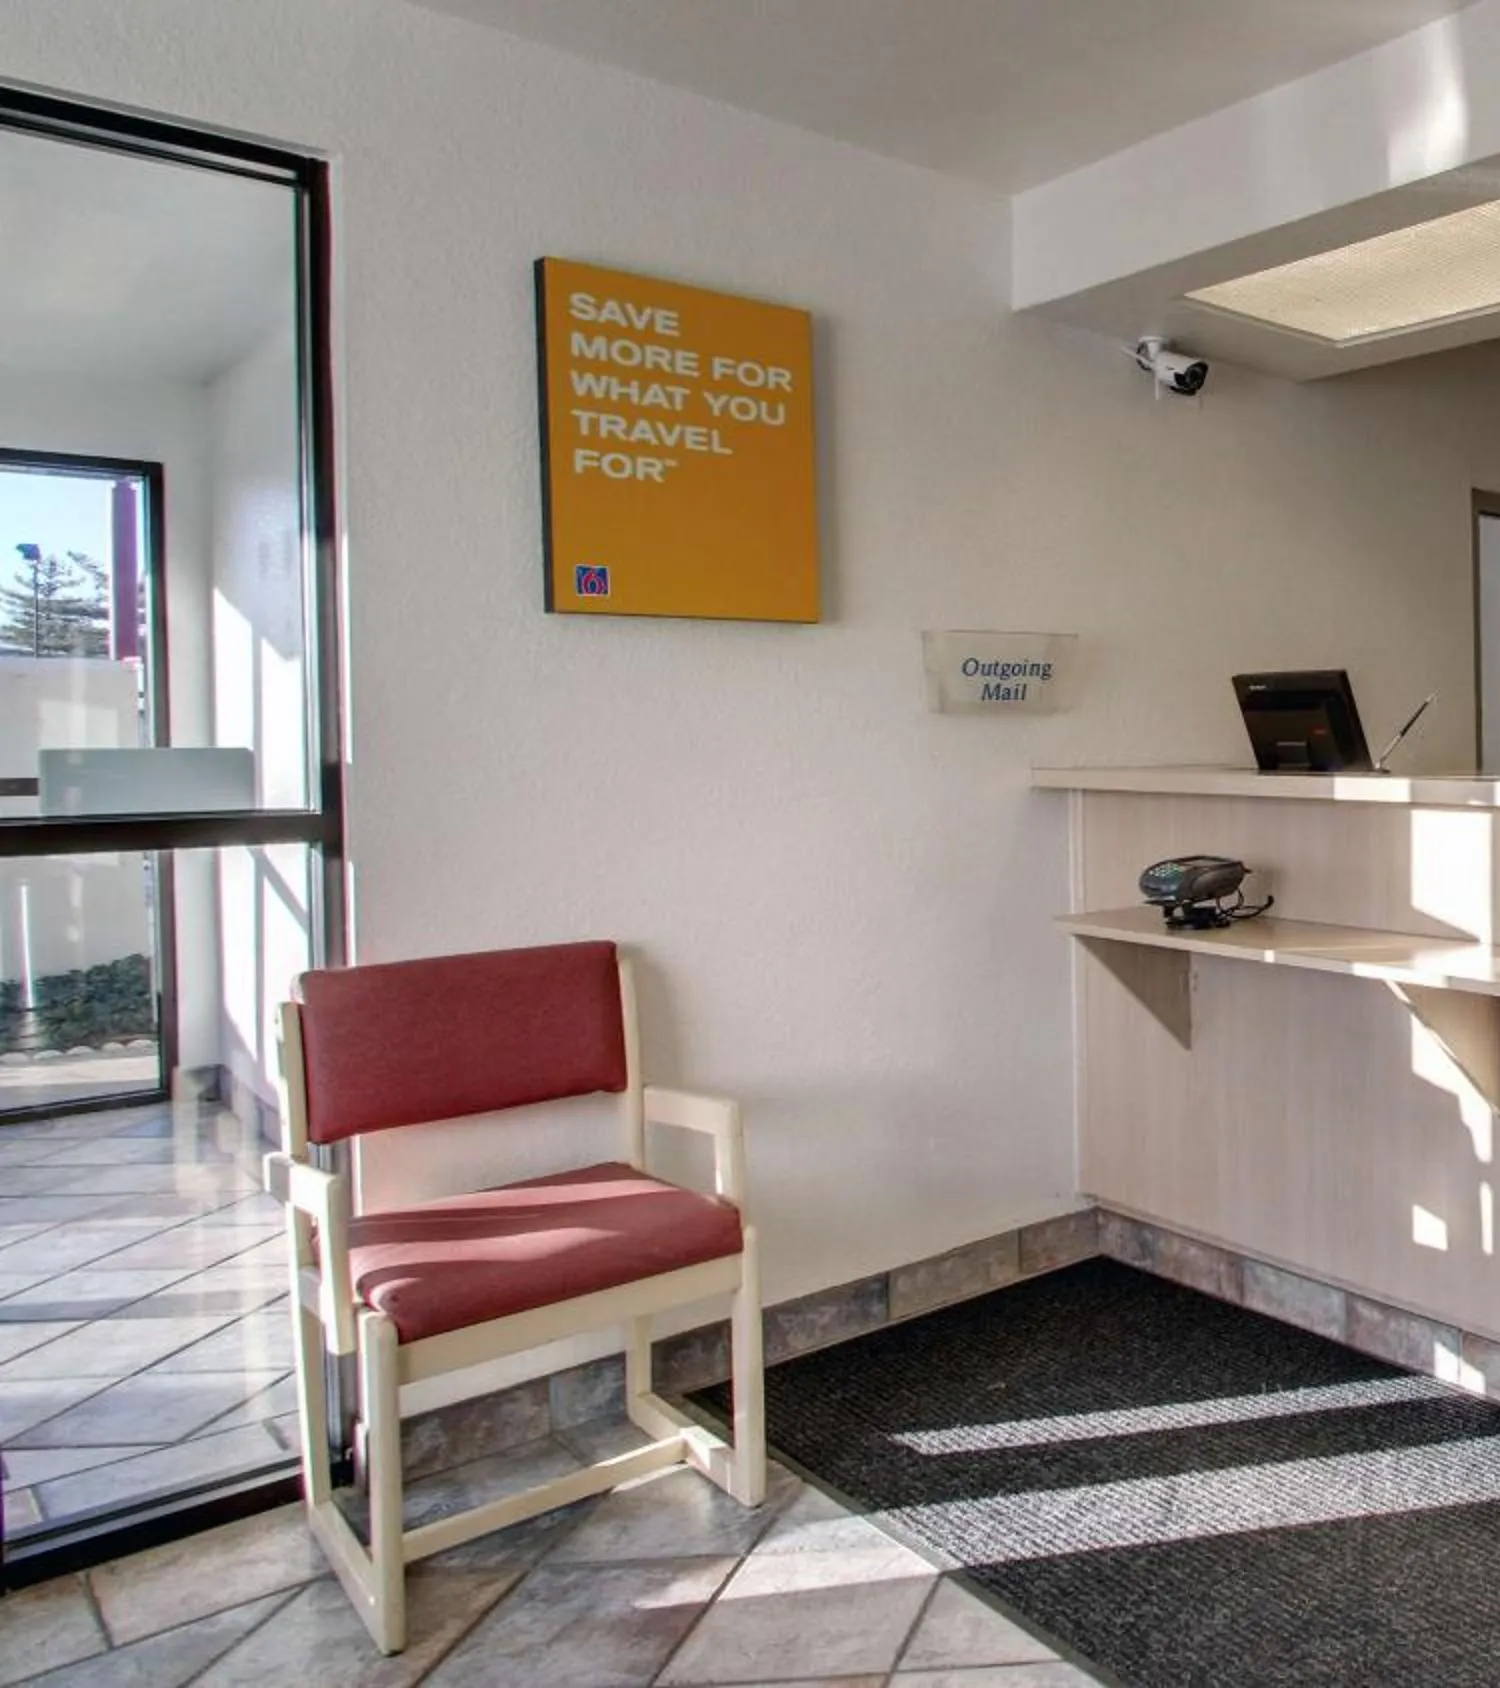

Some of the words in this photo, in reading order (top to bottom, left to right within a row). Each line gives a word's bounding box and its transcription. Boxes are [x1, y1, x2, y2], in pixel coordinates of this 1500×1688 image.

[569, 292, 680, 336] SAVE
[570, 331, 701, 378] MORE
[712, 356, 793, 392] FOR
[570, 370, 691, 412] WHAT
[703, 391, 786, 425] YOU
[570, 409, 734, 455] TRAVEL
[962, 657, 1052, 681] Outgoing
[981, 683, 1027, 701] Mail
